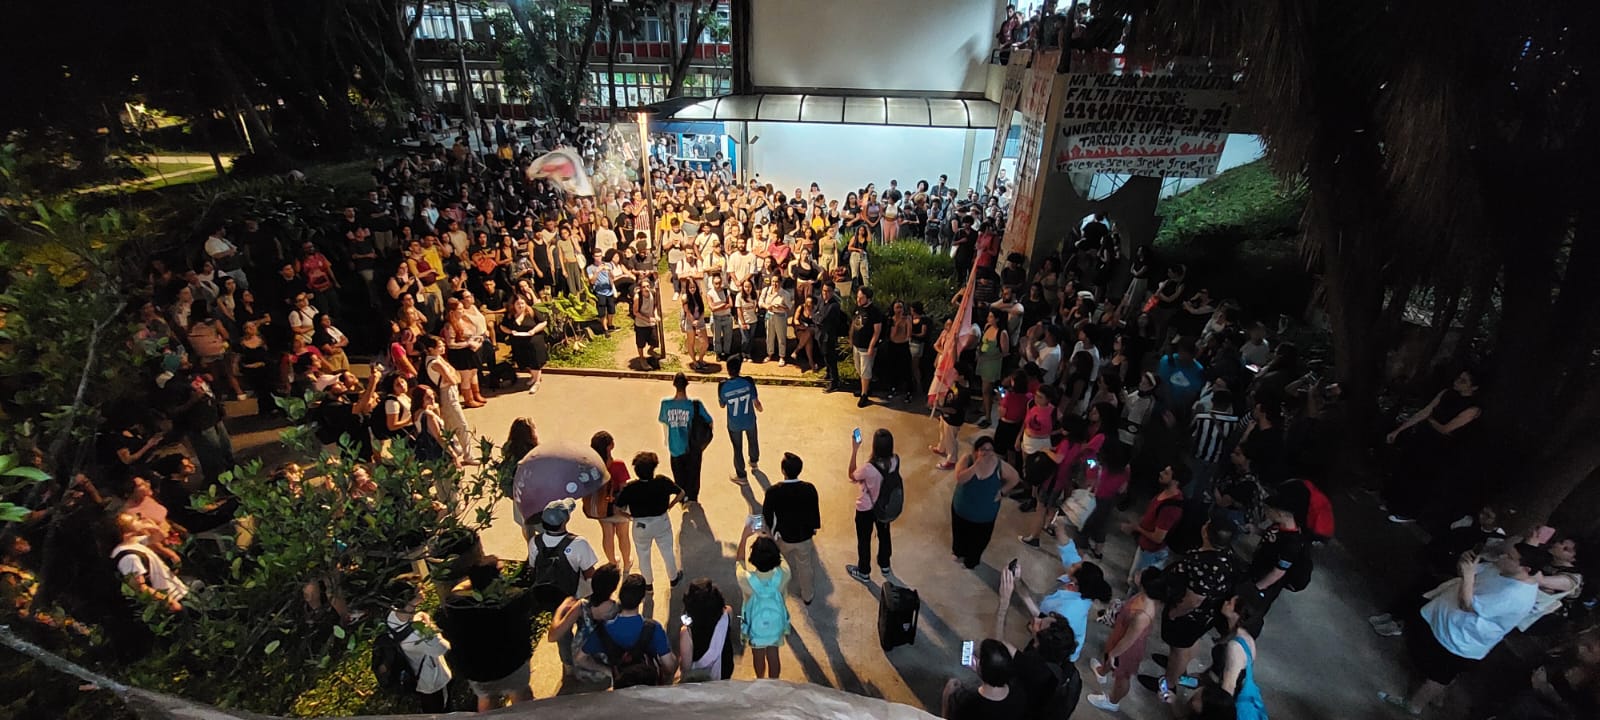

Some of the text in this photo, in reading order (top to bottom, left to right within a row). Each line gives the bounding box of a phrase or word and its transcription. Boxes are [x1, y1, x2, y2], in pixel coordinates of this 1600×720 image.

[1068, 74, 1088, 87] NA
[1066, 87, 1110, 101] FALTA
[1062, 121, 1118, 137] UNIFICAR
[1119, 122, 1136, 134] AS
[1138, 122, 1176, 136] LUTAS
[1129, 134, 1137, 146] E
[1138, 135, 1146, 146] O
[1166, 156, 1198, 170] greve
[727, 393, 750, 416] 77
